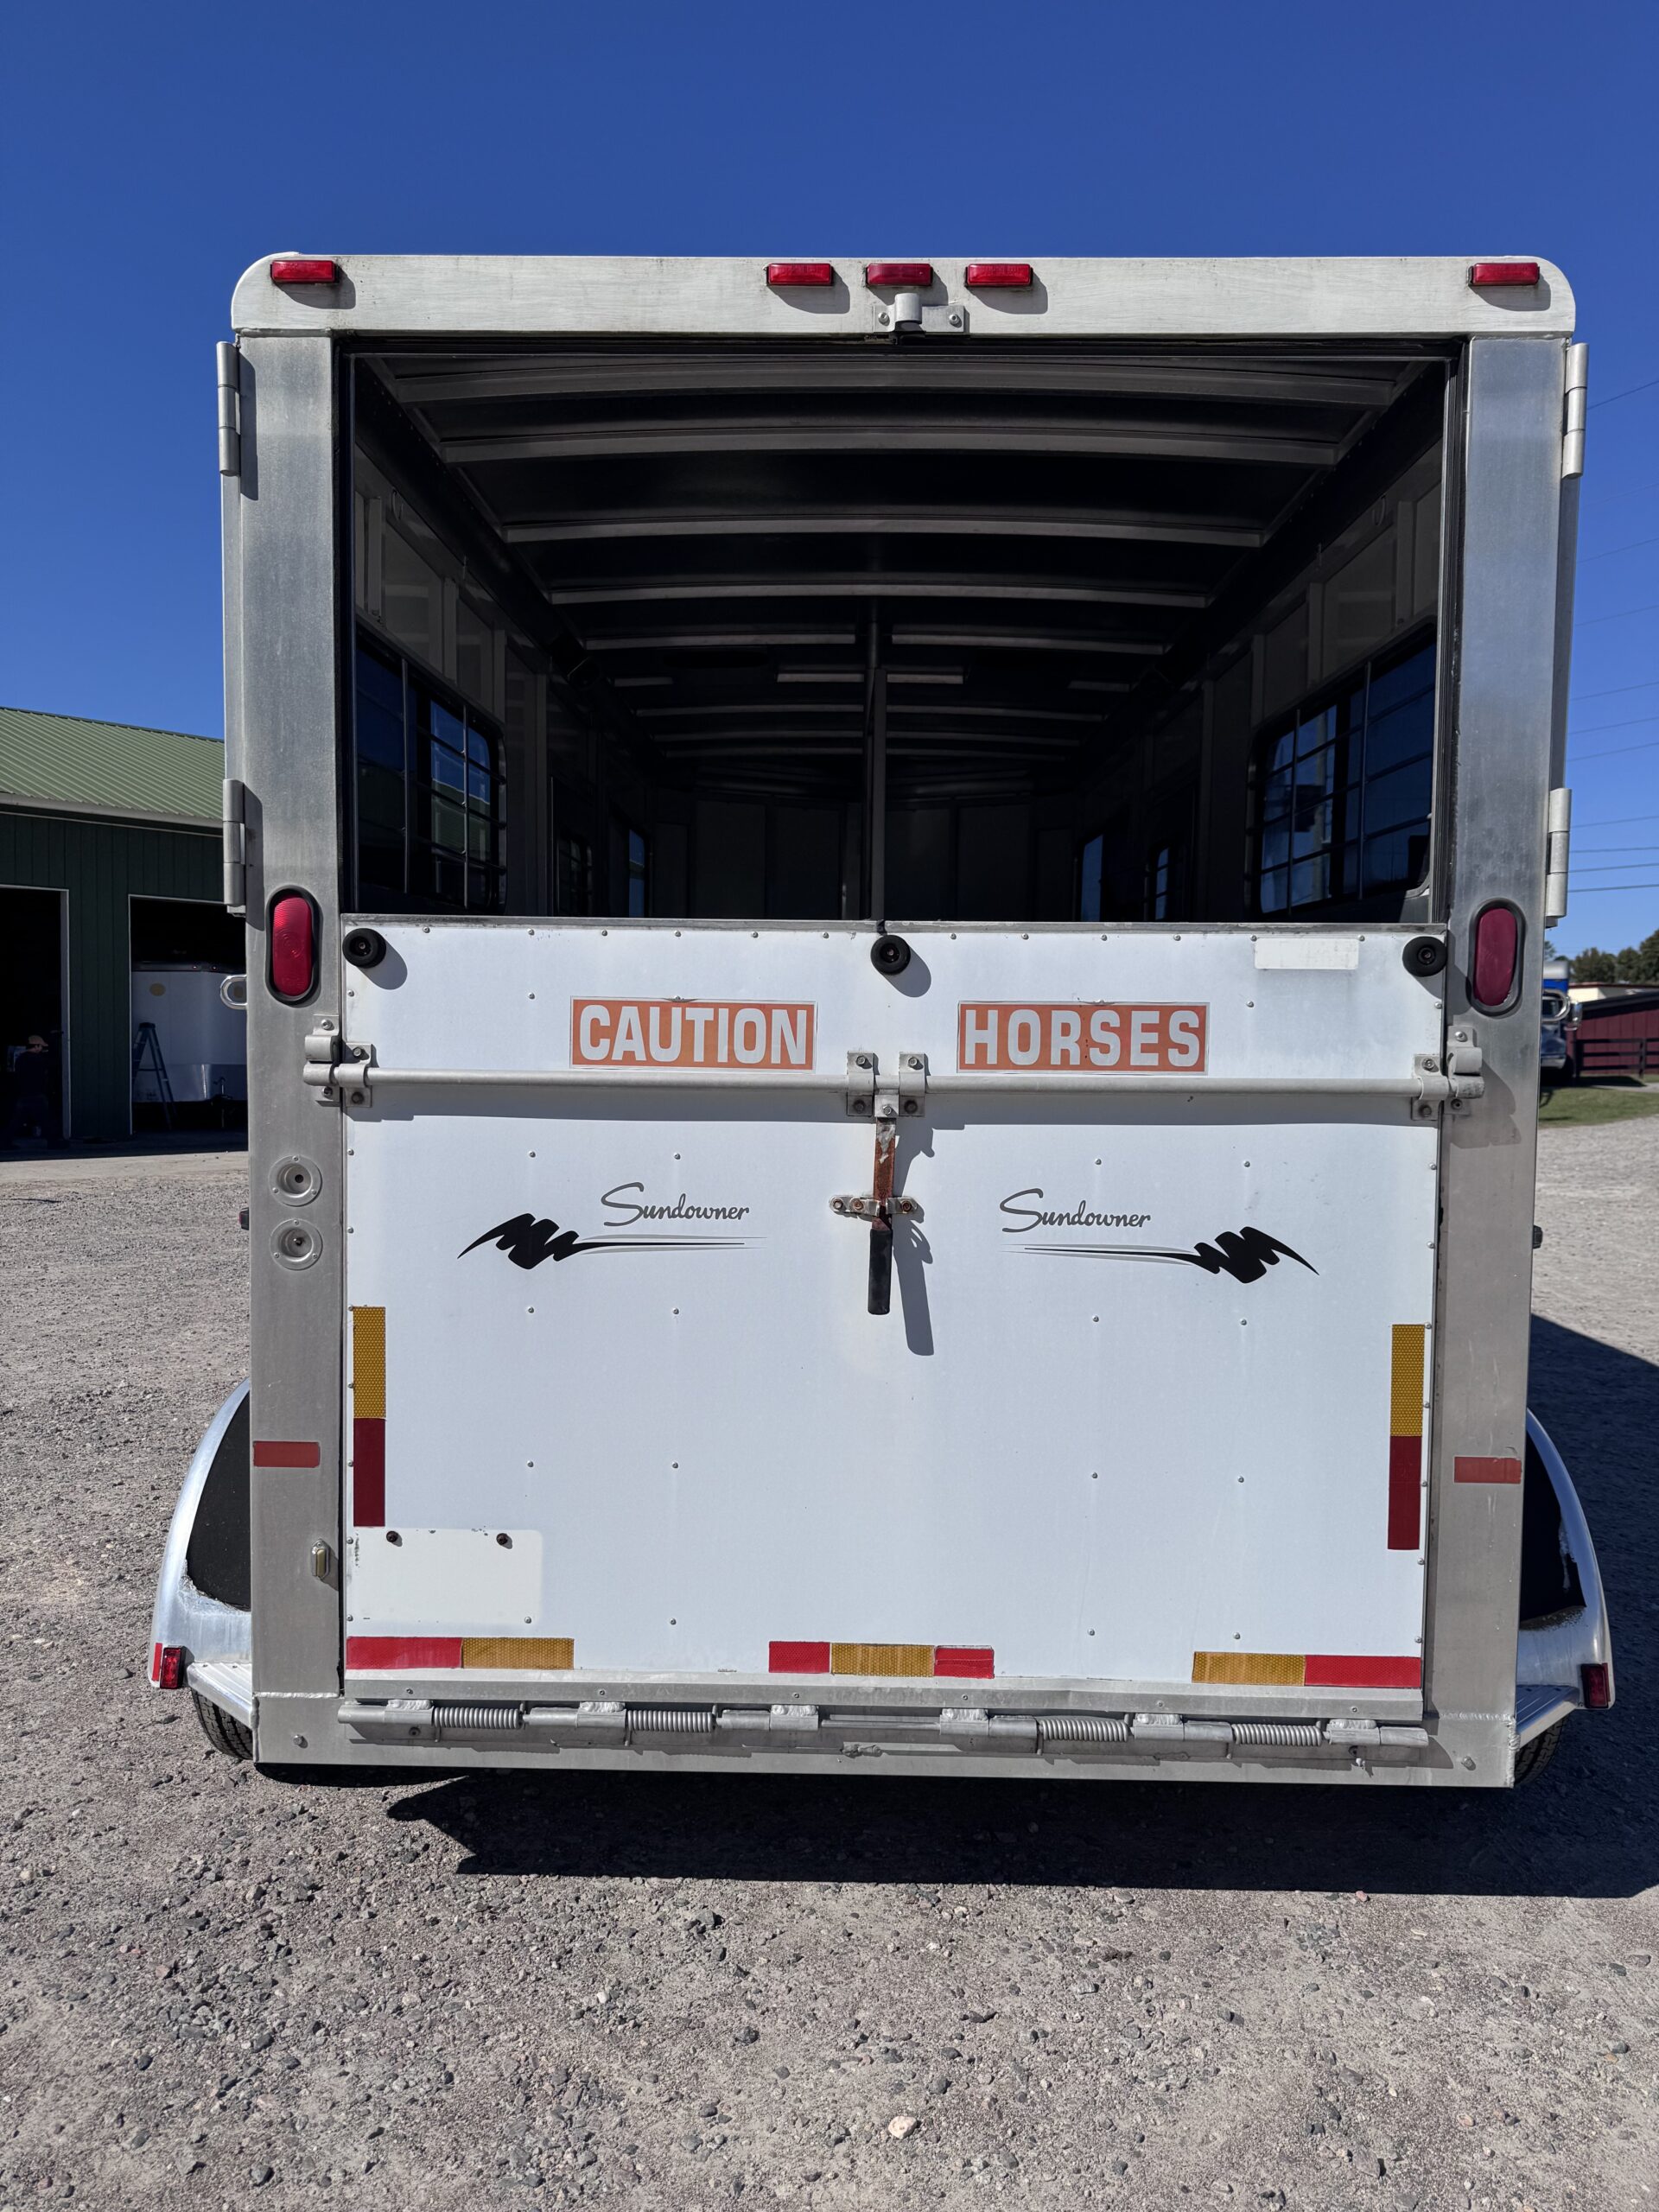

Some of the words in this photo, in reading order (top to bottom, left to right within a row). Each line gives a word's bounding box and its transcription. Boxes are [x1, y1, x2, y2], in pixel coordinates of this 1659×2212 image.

[579, 1004, 807, 1065] CAUTION
[964, 1008, 1200, 1067] HORSES
[601, 1181, 750, 1227] Sundowner
[999, 1187, 1151, 1233] Sundowner
